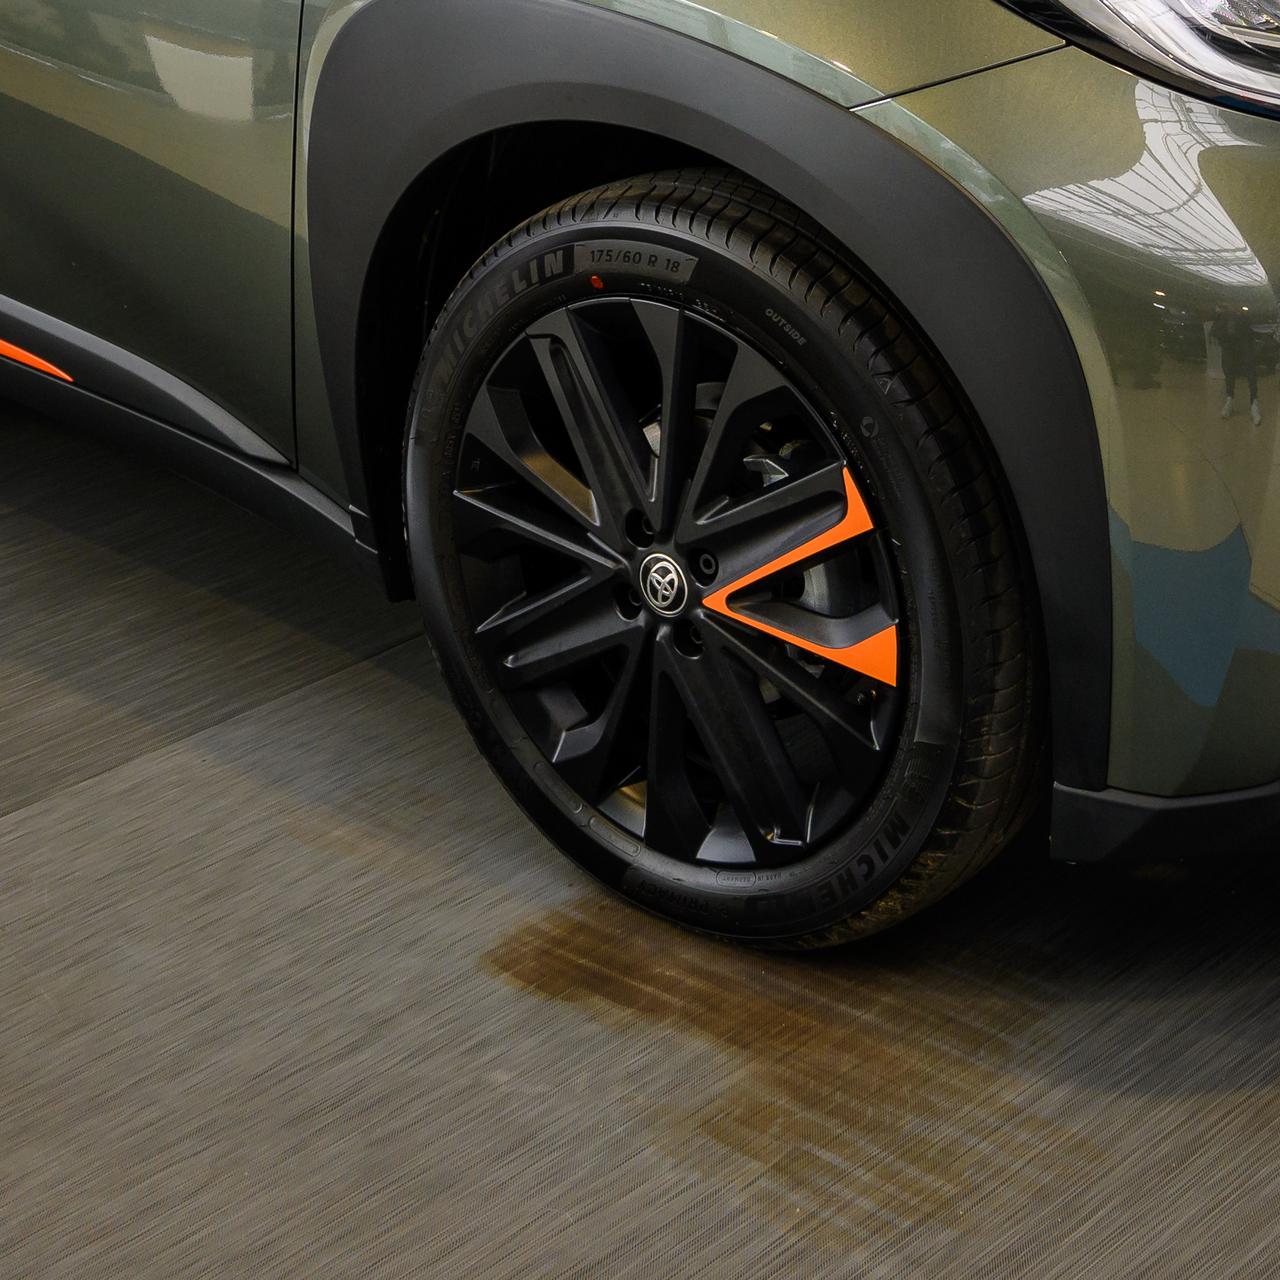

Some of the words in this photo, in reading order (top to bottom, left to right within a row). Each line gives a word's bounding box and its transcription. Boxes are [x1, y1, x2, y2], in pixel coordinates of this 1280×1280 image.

[590, 248, 642, 266] 175/60
[647, 253, 658, 268] R
[665, 257, 681, 274] 18
[764, 307, 808, 347] OUTSIDE
